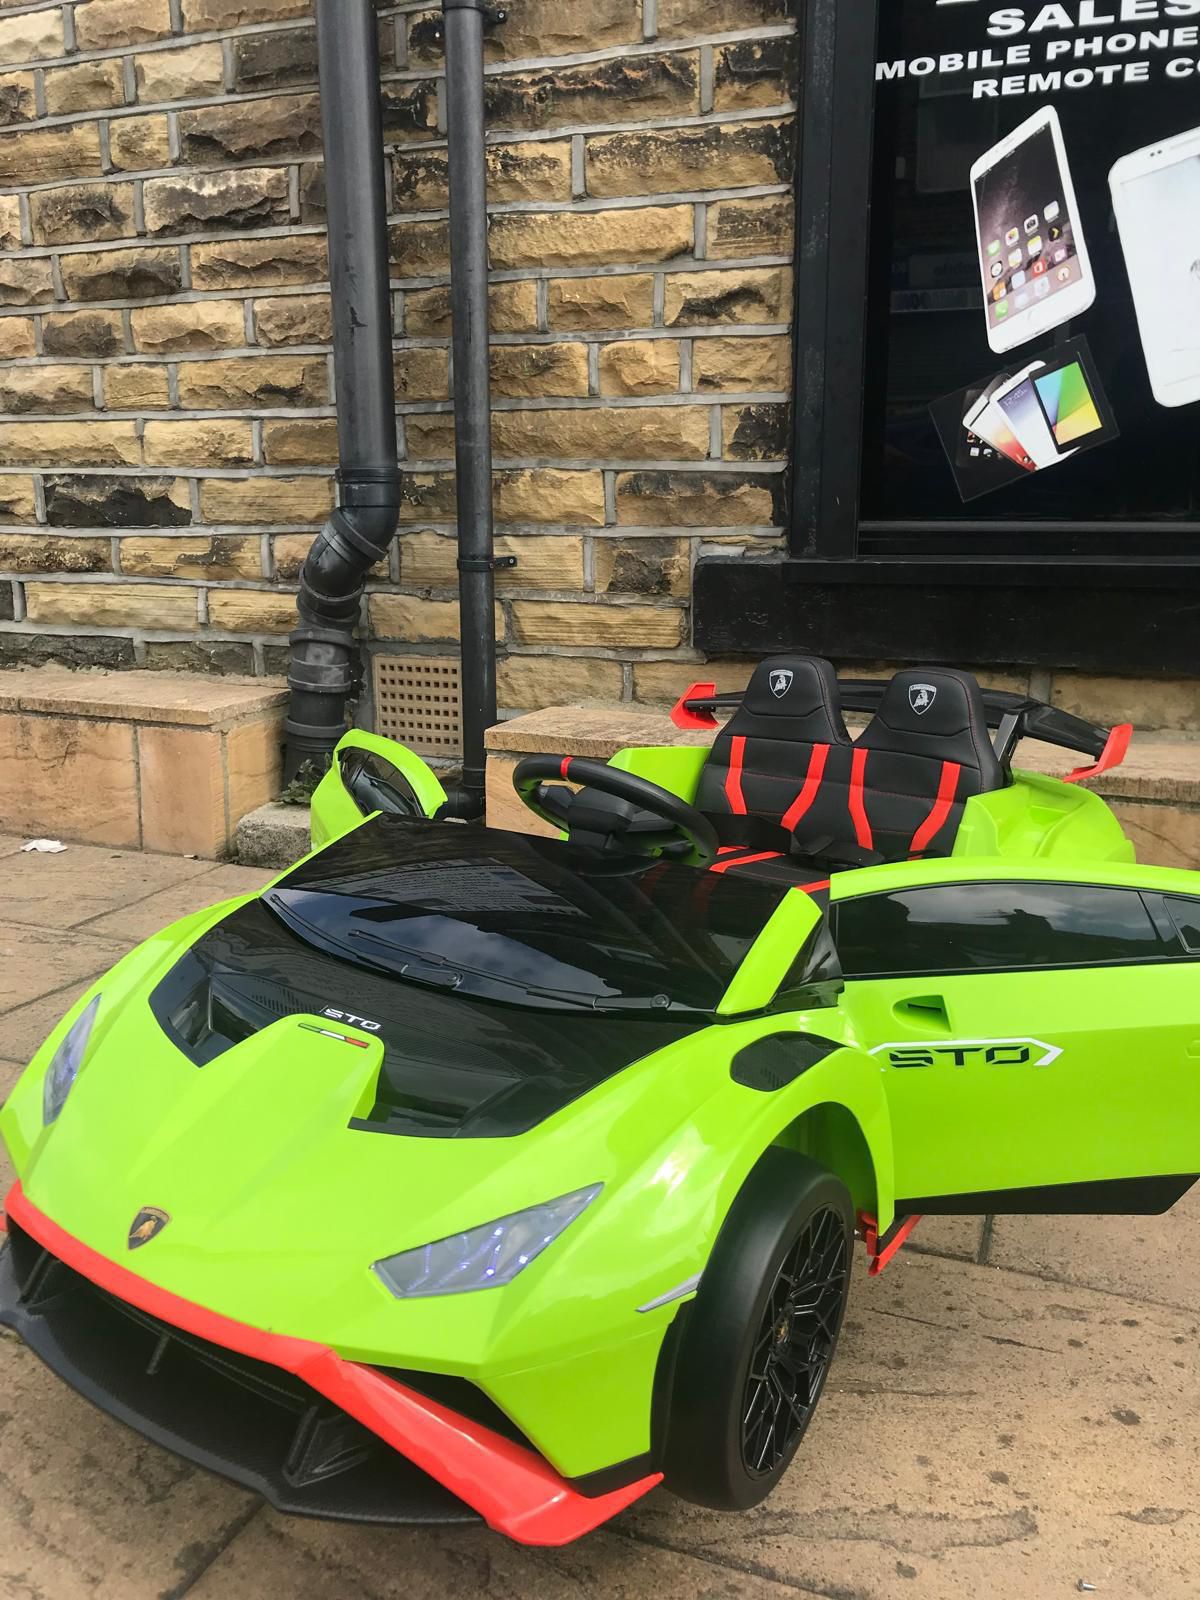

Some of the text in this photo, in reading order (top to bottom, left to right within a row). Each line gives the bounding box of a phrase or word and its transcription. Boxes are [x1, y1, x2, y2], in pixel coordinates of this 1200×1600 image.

[986, 0, 1200, 36] SALES
[875, 26, 1199, 80] MOBILE PHONE
[972, 57, 1200, 99] REMOTE C
[323, 1008, 381, 1030] STO
[889, 1045, 1030, 1069] STO
